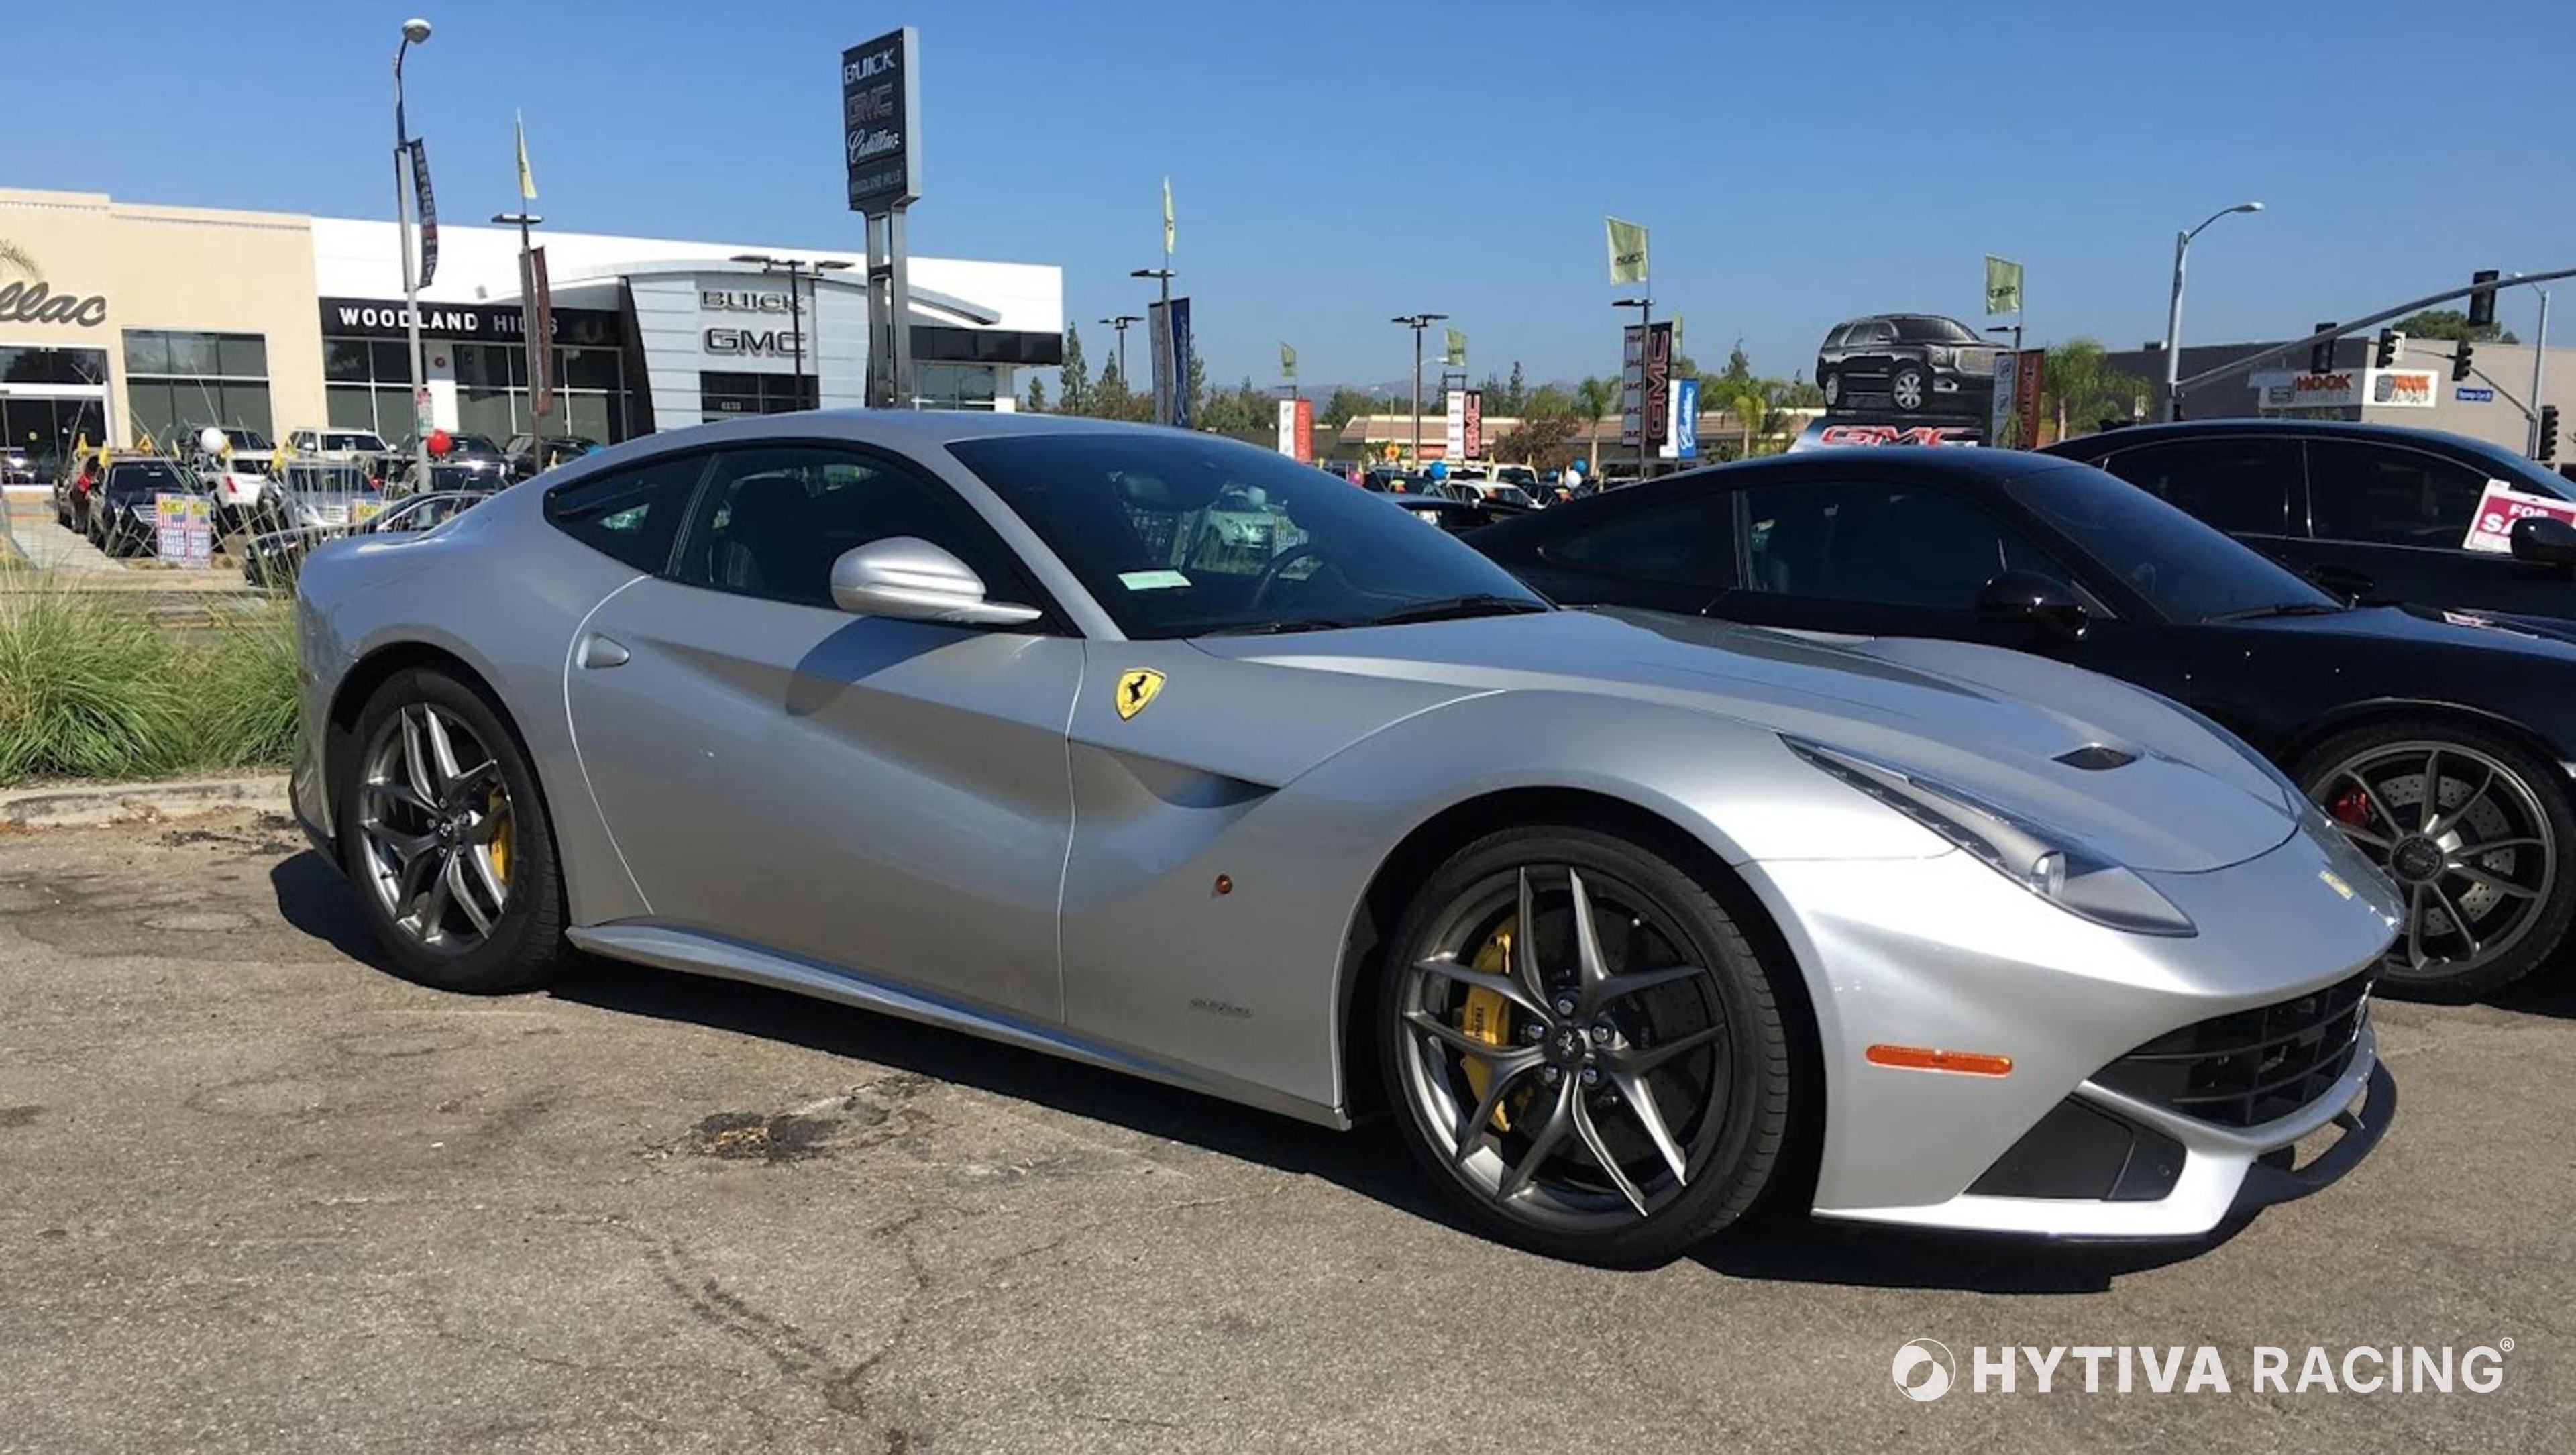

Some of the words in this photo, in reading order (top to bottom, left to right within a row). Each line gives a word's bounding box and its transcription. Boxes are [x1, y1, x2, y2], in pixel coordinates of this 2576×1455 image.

[844, 48, 896, 85] BUICK
[701, 291, 807, 314] BUICK
[339, 307, 479, 331] WOODLAND
[493, 314, 558, 335] HILS
[704, 327, 807, 358] GMC
[1647, 330, 1669, 439] GMC
[2296, 372, 2352, 392] HOOK
[1465, 394, 1481, 457] GMC
[1820, 424, 1983, 447] GMC
